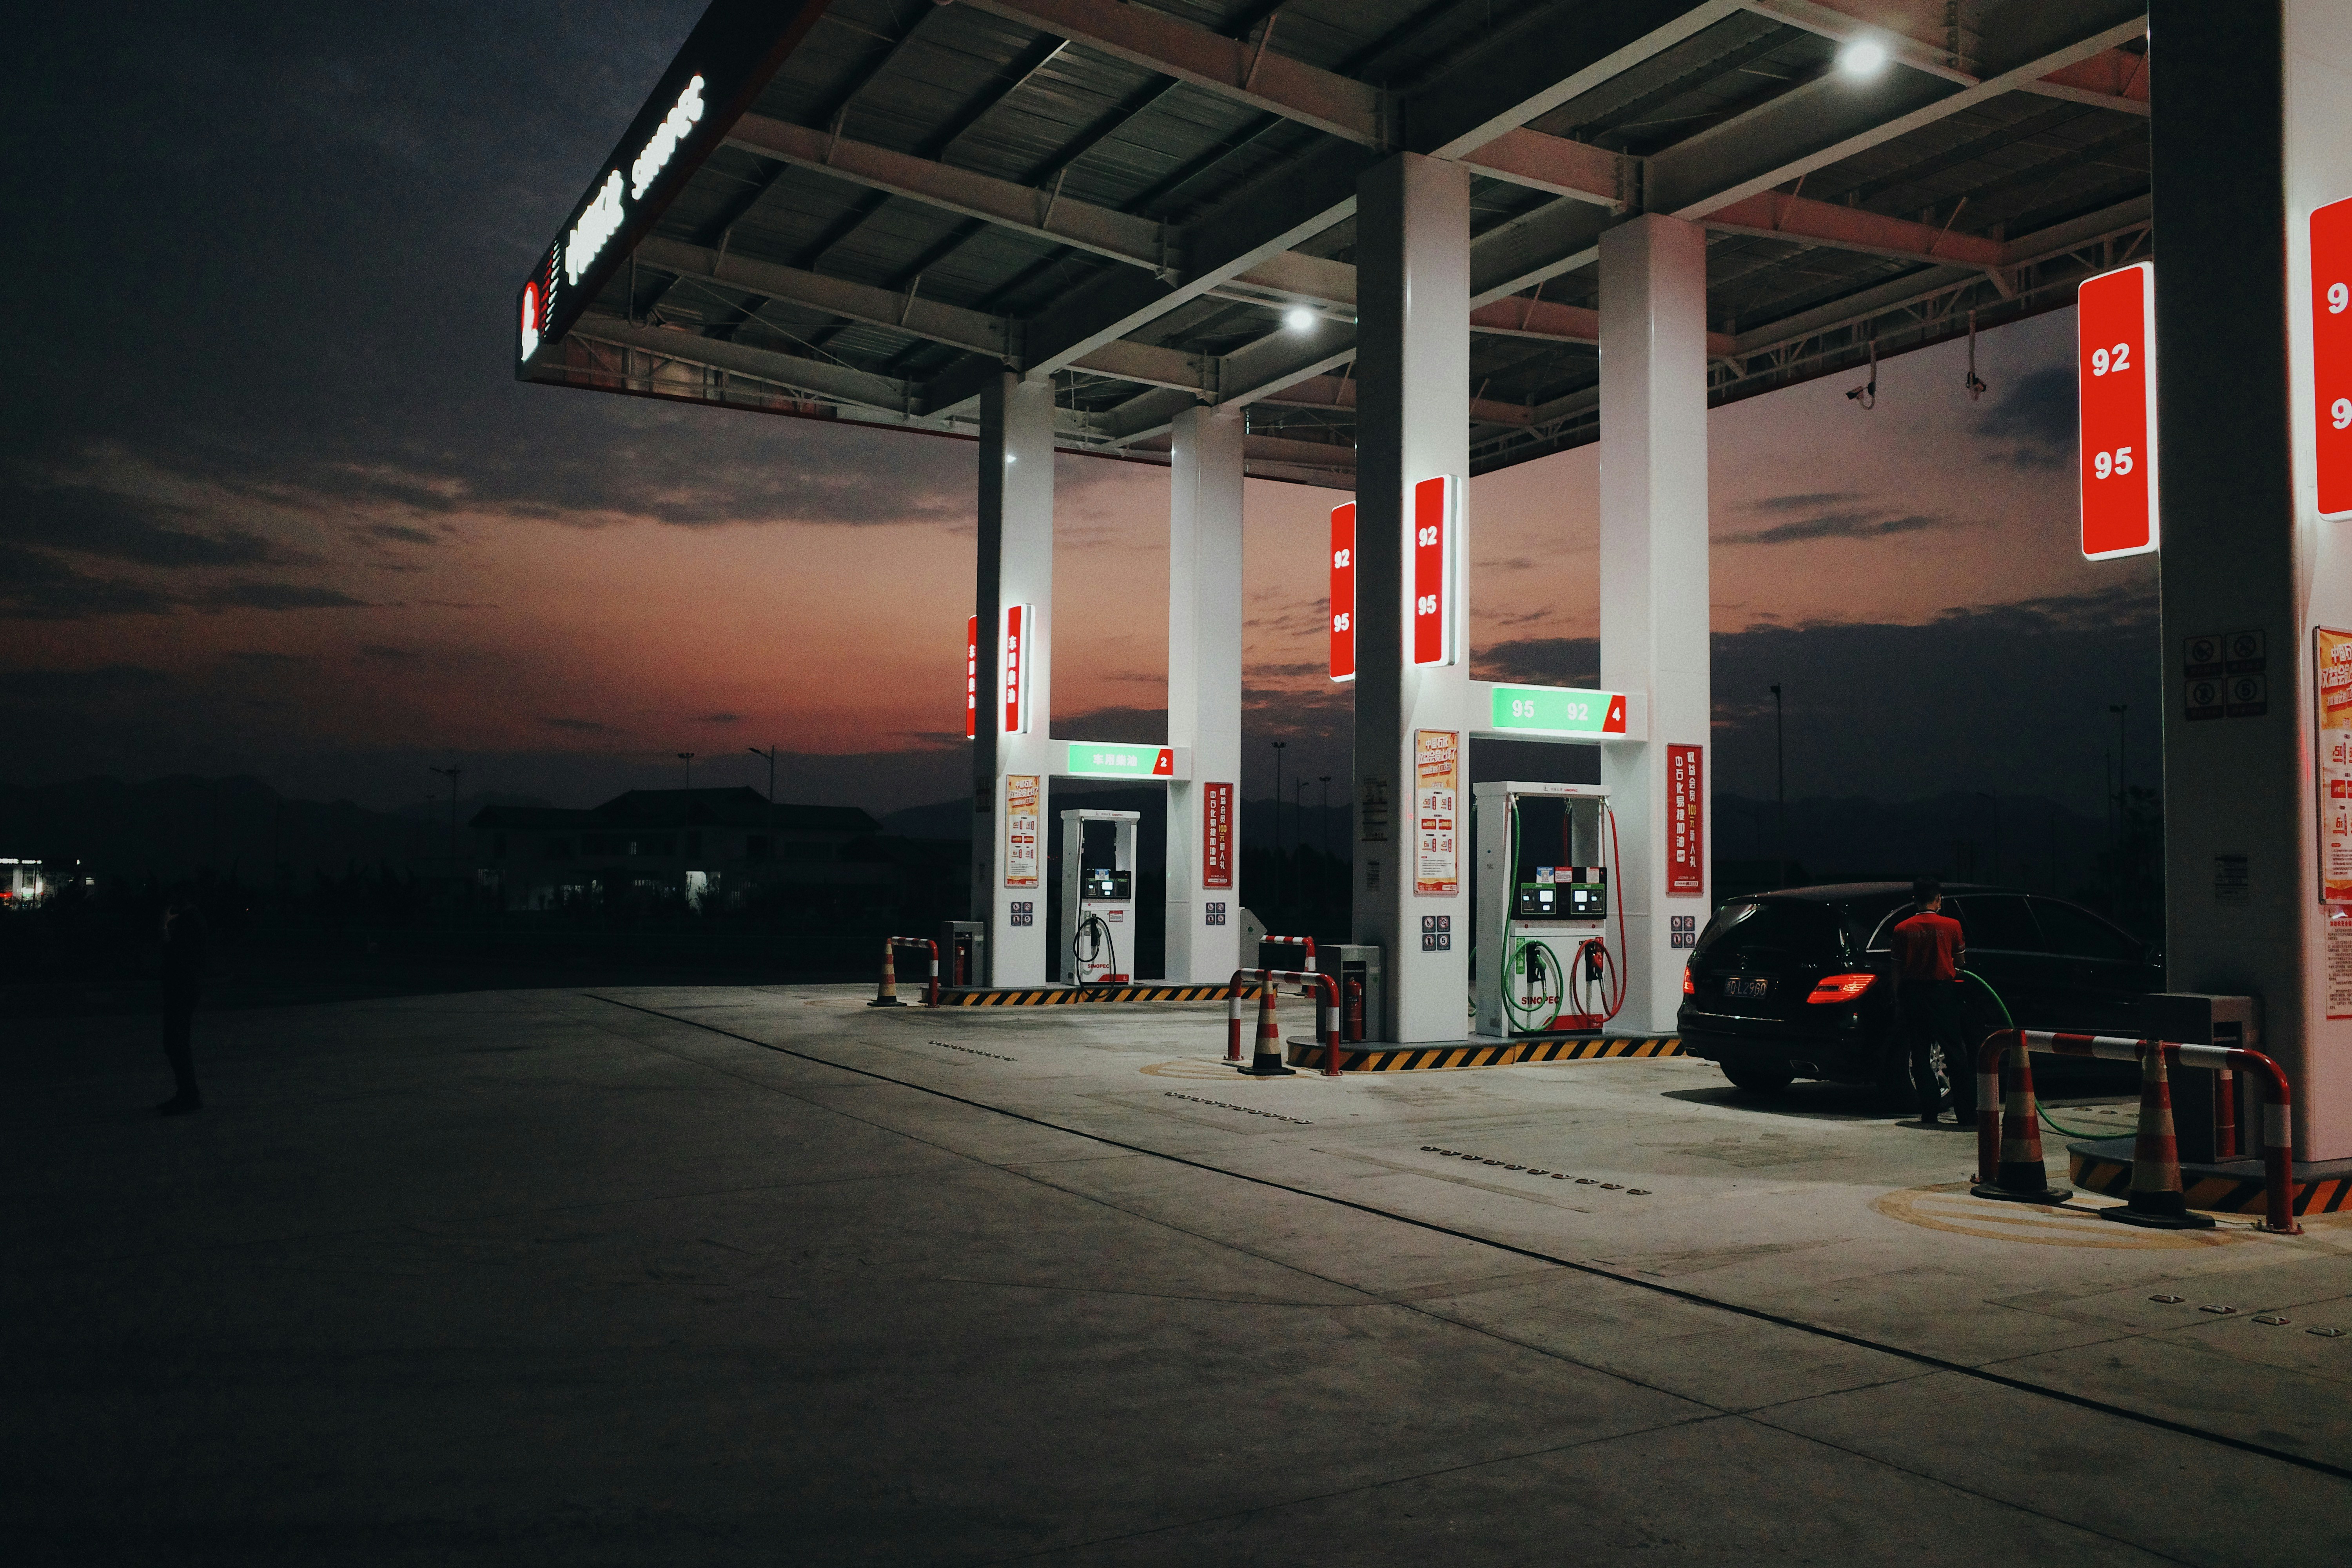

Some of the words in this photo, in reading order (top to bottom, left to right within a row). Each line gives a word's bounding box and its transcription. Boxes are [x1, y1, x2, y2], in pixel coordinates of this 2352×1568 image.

[2327, 282, 2352, 314] 9
[2092, 343, 2130, 376] 92
[2094, 446, 2133, 479] 95
[1419, 526, 1437, 547] 92
[1334, 548, 1350, 569] 92
[1418, 594, 1437, 616] 95
[1334, 612, 1349, 632] 95
[2330, 642, 2352, 663] 中国石
[1007, 635, 1017, 704] 车用柴油
[1512, 699, 1535, 718] 95
[1567, 702, 1588, 721] 92
[1612, 707, 1621, 721] 4
[1425, 735, 1448, 750] 中国石化
[1093, 753, 1138, 766] 车用柴油
[1160, 757, 1167, 767] 2
[1418, 747, 1457, 764] 权益会员上线了
